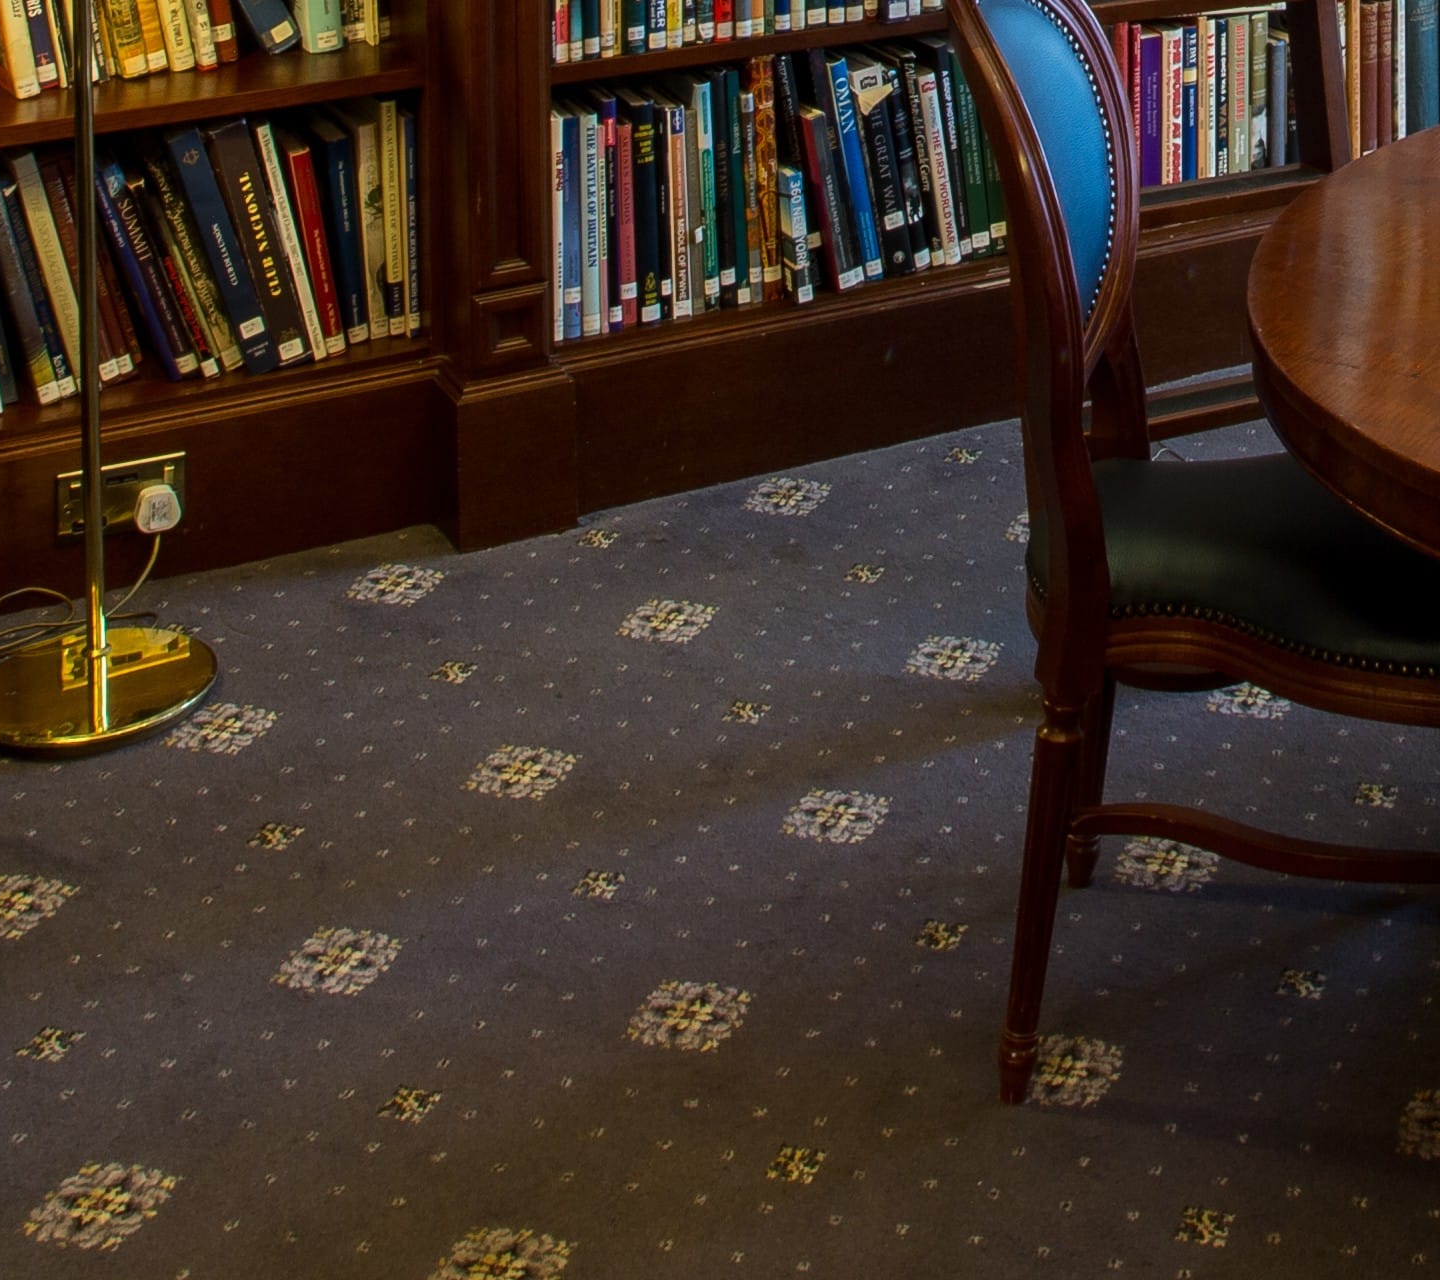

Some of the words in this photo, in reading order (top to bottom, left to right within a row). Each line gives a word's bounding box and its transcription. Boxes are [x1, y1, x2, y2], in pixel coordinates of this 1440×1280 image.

[835, 76, 855, 134] OMAN
[120, 198, 150, 262] SUMMIT
[239, 170, 269, 252] NACIONAL
[262, 256, 281, 297] CLUB
